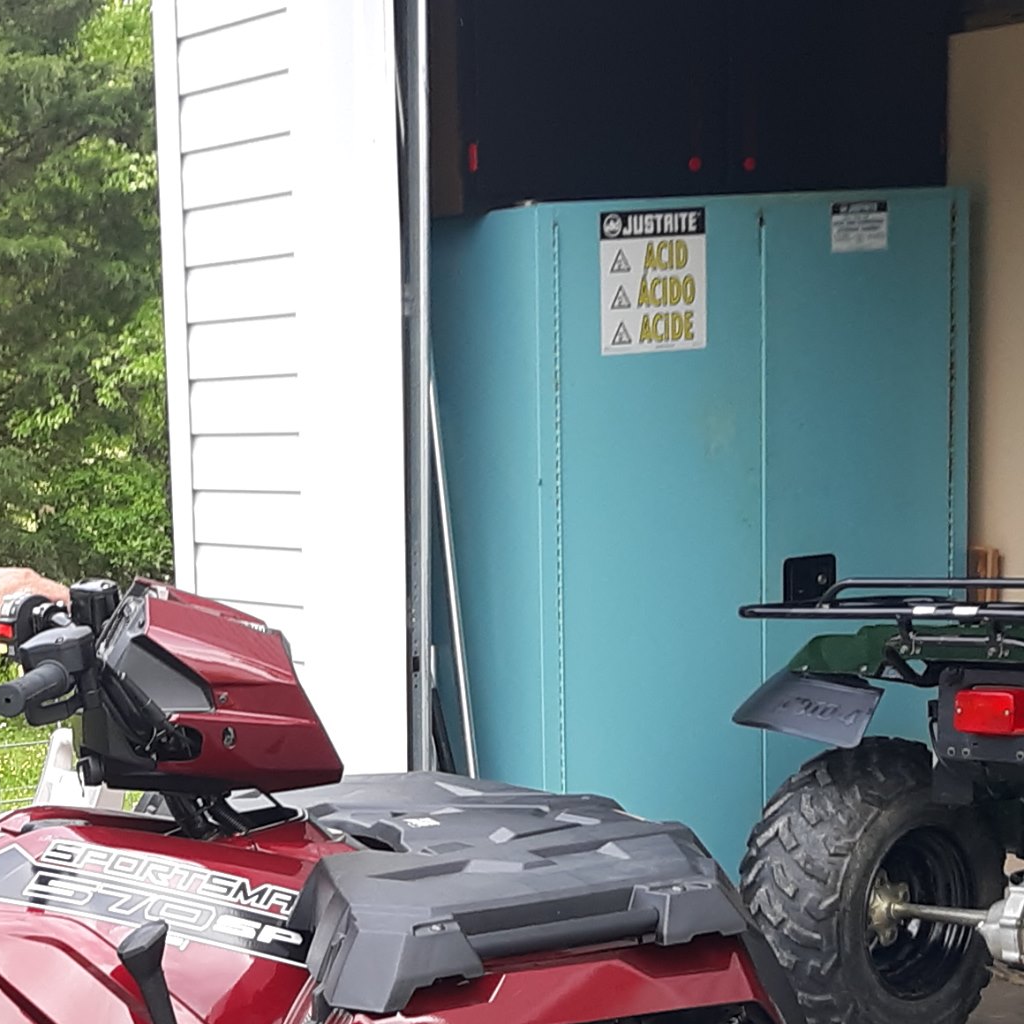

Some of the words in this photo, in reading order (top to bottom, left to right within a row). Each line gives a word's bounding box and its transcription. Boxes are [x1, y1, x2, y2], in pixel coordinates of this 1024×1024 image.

[622, 211, 697, 236] JUSTRITE
[644, 239, 689, 271] ACID
[639, 311, 695, 344] ACIDE
